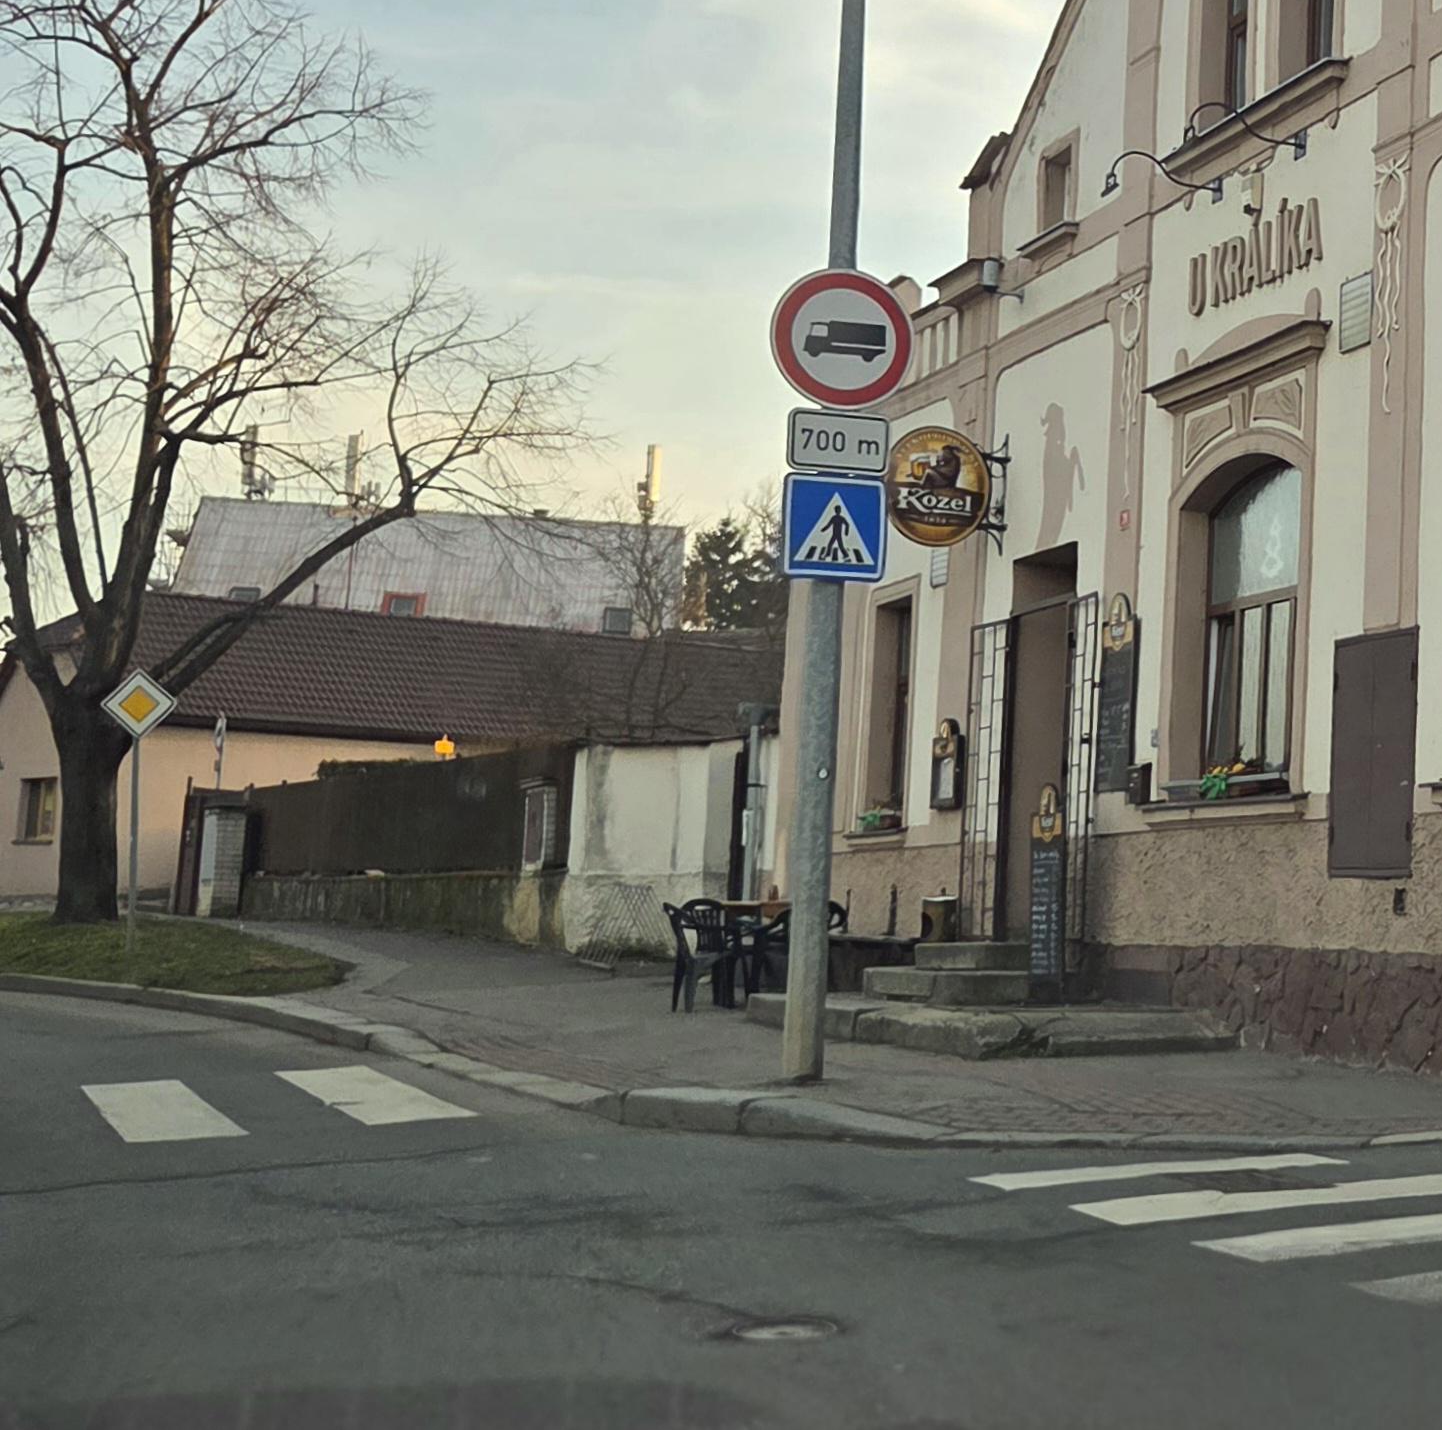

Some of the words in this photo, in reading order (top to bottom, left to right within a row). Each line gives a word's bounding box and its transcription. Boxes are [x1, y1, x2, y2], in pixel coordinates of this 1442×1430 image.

[1188, 253, 1207, 317] U
[801, 428, 846, 452] 700
[857, 438, 880, 456] m
[896, 487, 973, 516] Kozel
